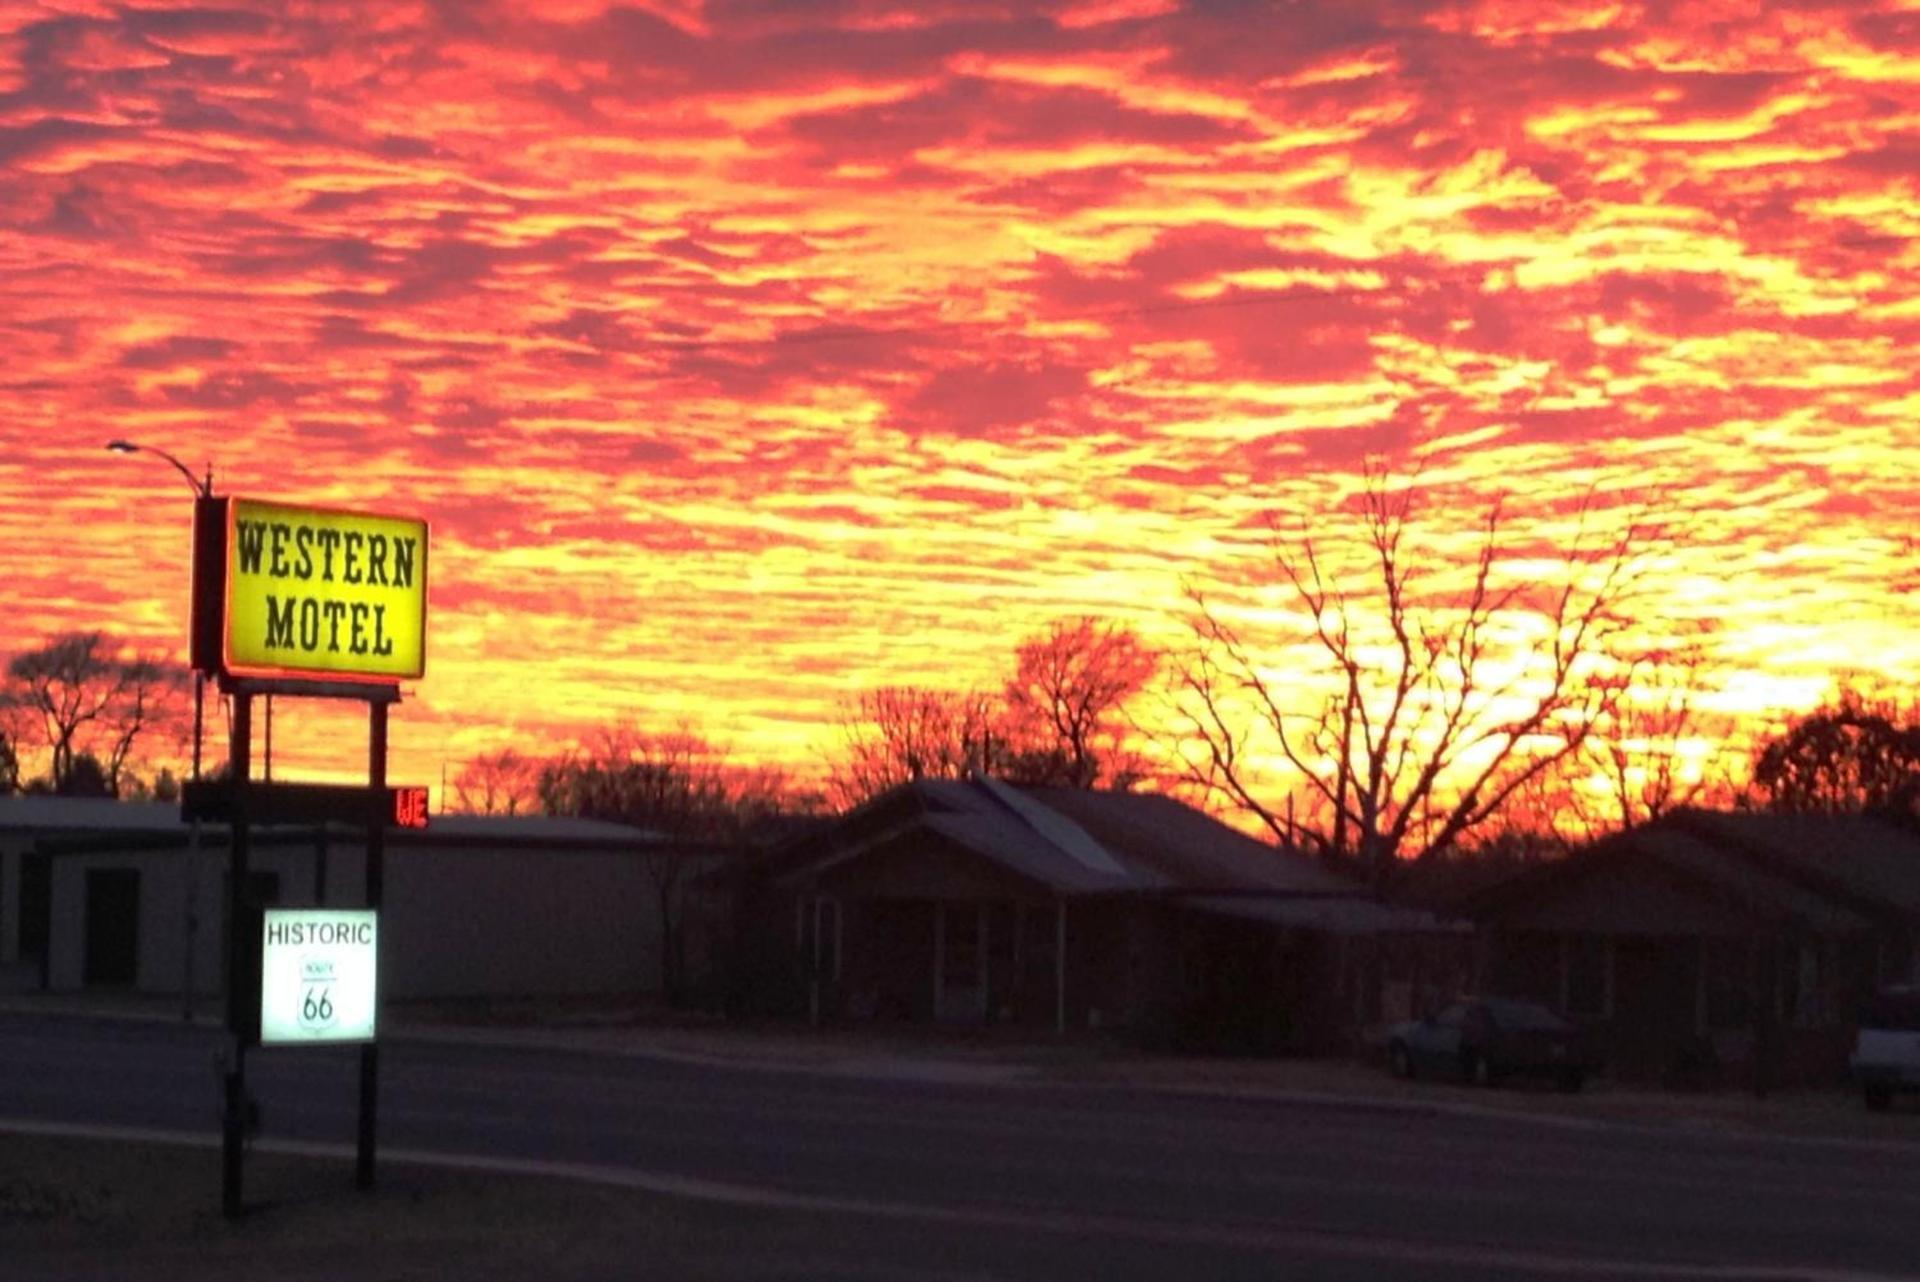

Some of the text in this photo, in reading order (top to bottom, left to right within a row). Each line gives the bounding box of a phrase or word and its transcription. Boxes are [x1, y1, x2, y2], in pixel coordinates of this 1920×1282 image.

[236, 520, 416, 588] WESTERN
[264, 595, 392, 656] MOTEL
[268, 922, 372, 945] HISTORIC
[303, 987, 333, 1020] 66
